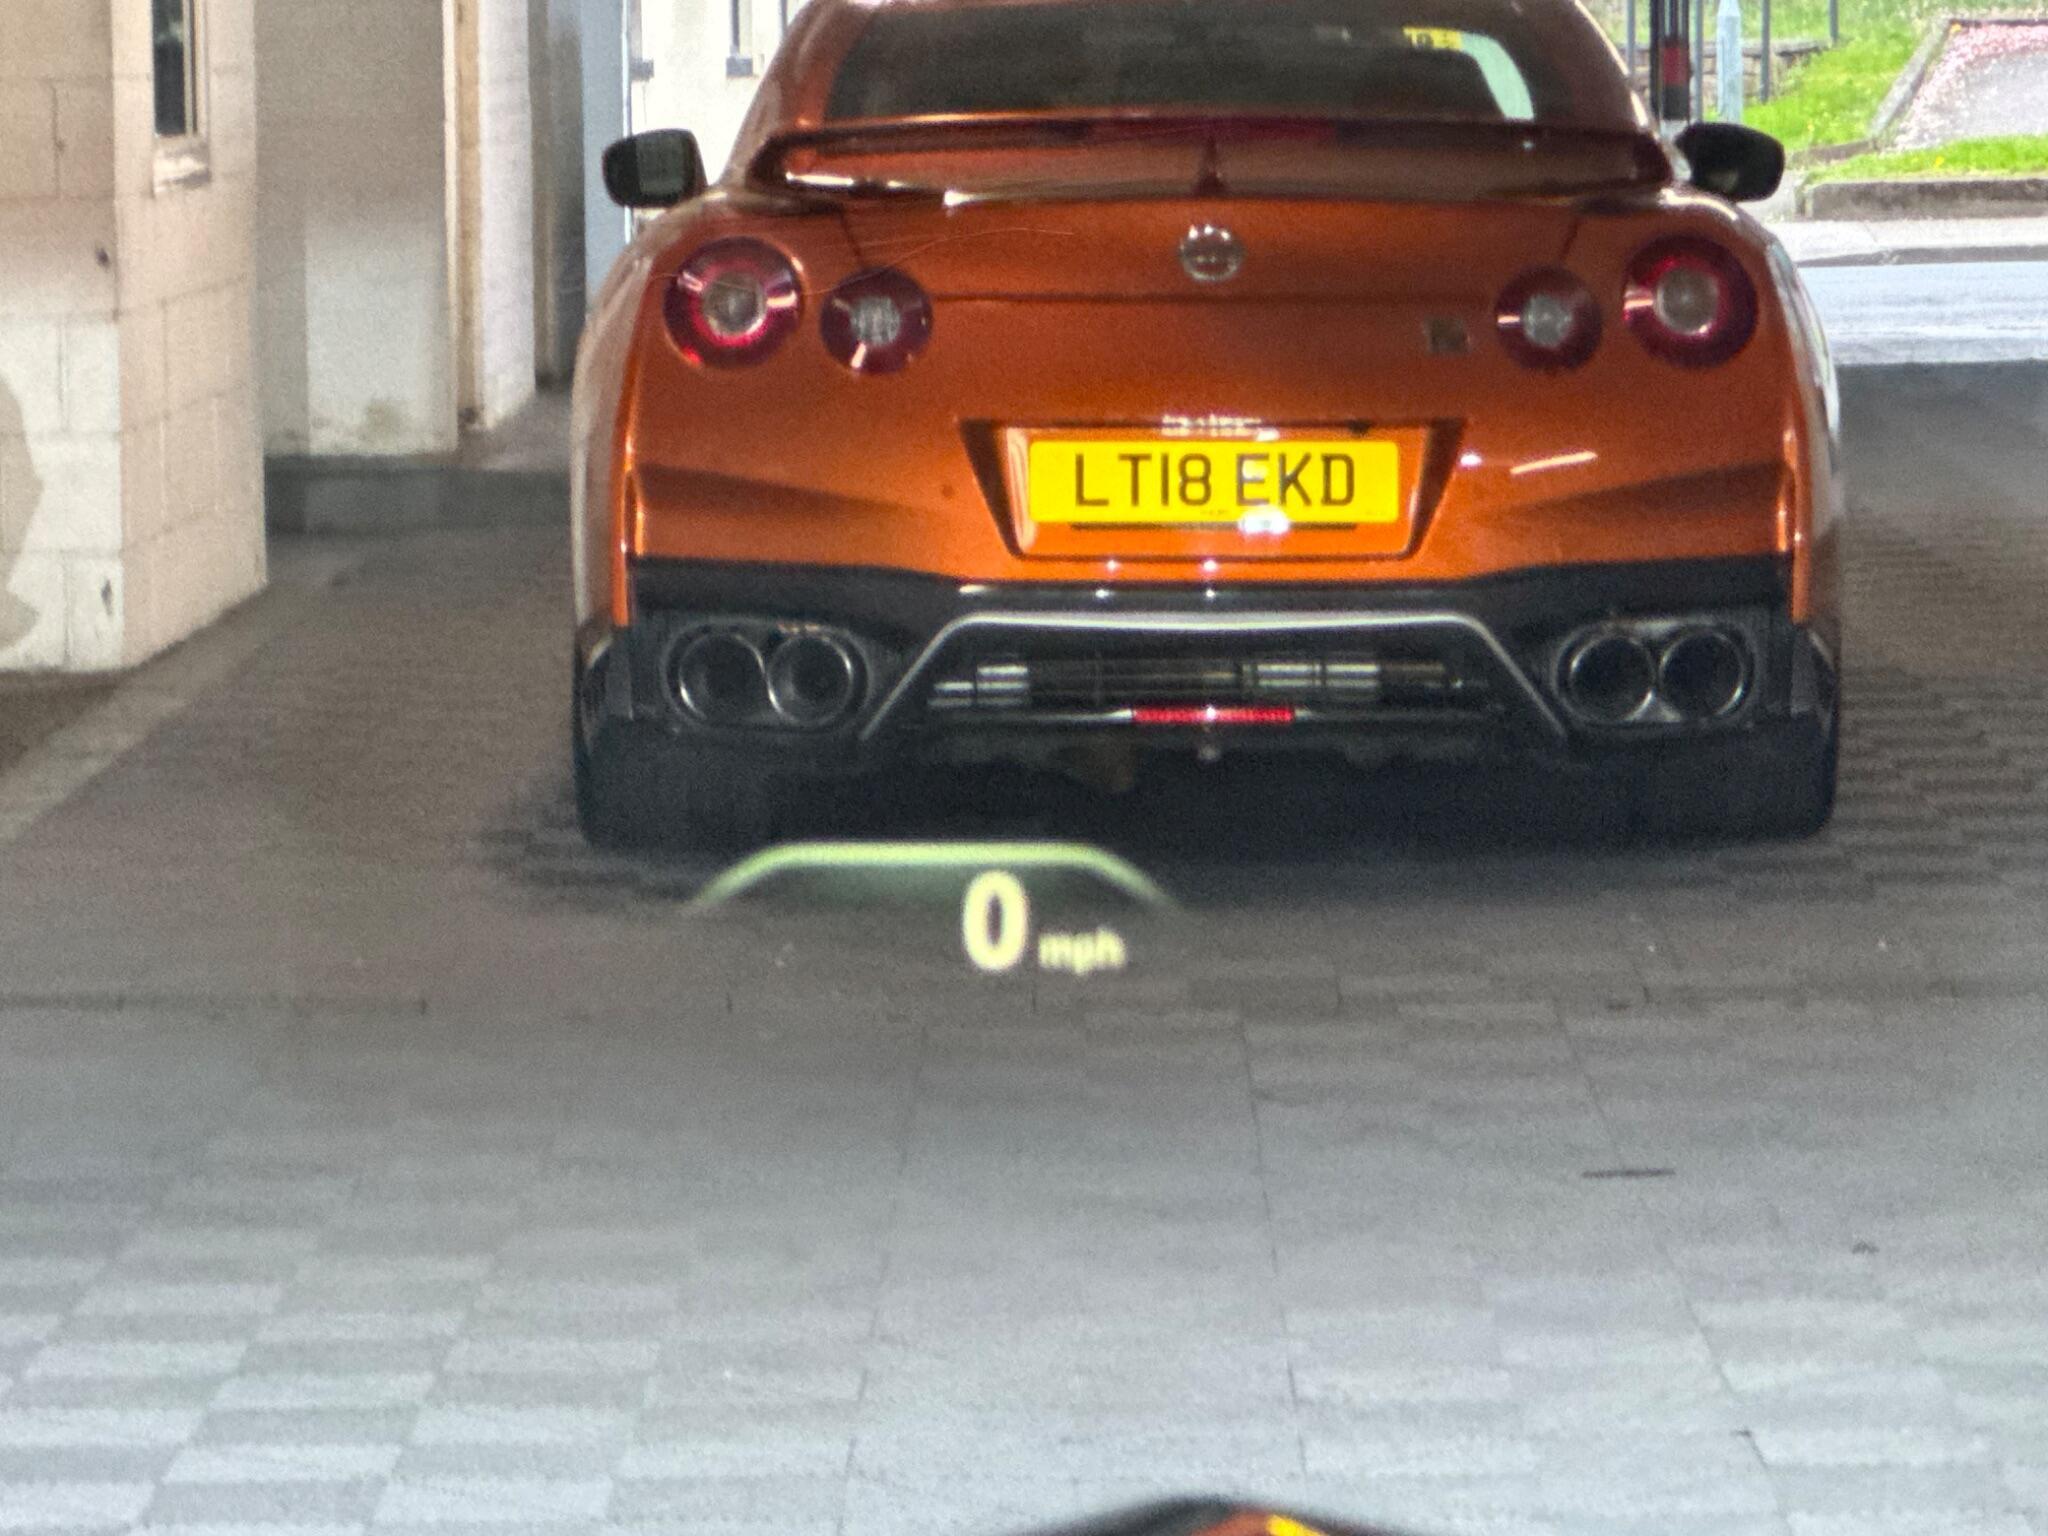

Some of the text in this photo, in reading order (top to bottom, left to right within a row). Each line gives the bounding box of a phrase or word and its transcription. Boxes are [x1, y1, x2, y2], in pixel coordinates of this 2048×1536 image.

[1075, 453, 1356, 507] LT18 EKD
[963, 870, 1126, 975] 0 mph
